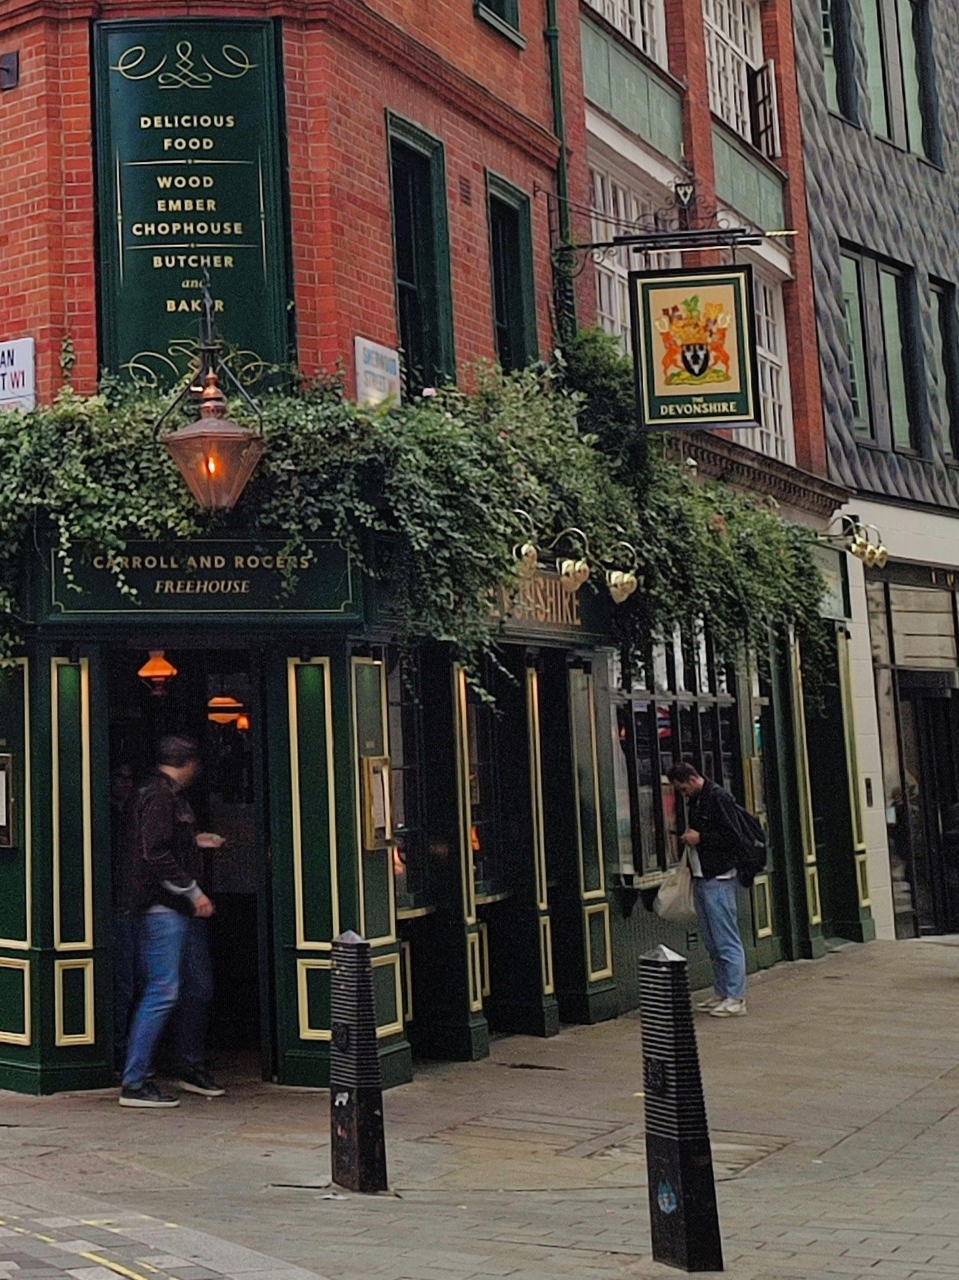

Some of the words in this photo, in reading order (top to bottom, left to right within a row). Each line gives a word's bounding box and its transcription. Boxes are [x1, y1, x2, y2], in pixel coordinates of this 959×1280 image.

[140, 115, 235, 129] DELICIOUS
[163, 138, 214, 151] FOOD
[157, 176, 214, 189] WOOD
[157, 199, 217, 212] EMBER
[132, 222, 243, 236] CHOPHOUSE
[152, 255, 234, 268] BUTCHER
[181, 279, 205, 289] an
[166, 299, 224, 312] BAKR
[10, 370, 25, 389] W1
[660, 401, 737, 416] DEVONSHIRE
[93, 555, 178, 569] CARROLL
[188, 555, 226, 569] AND
[154, 580, 250, 594] FREEHOUSE
